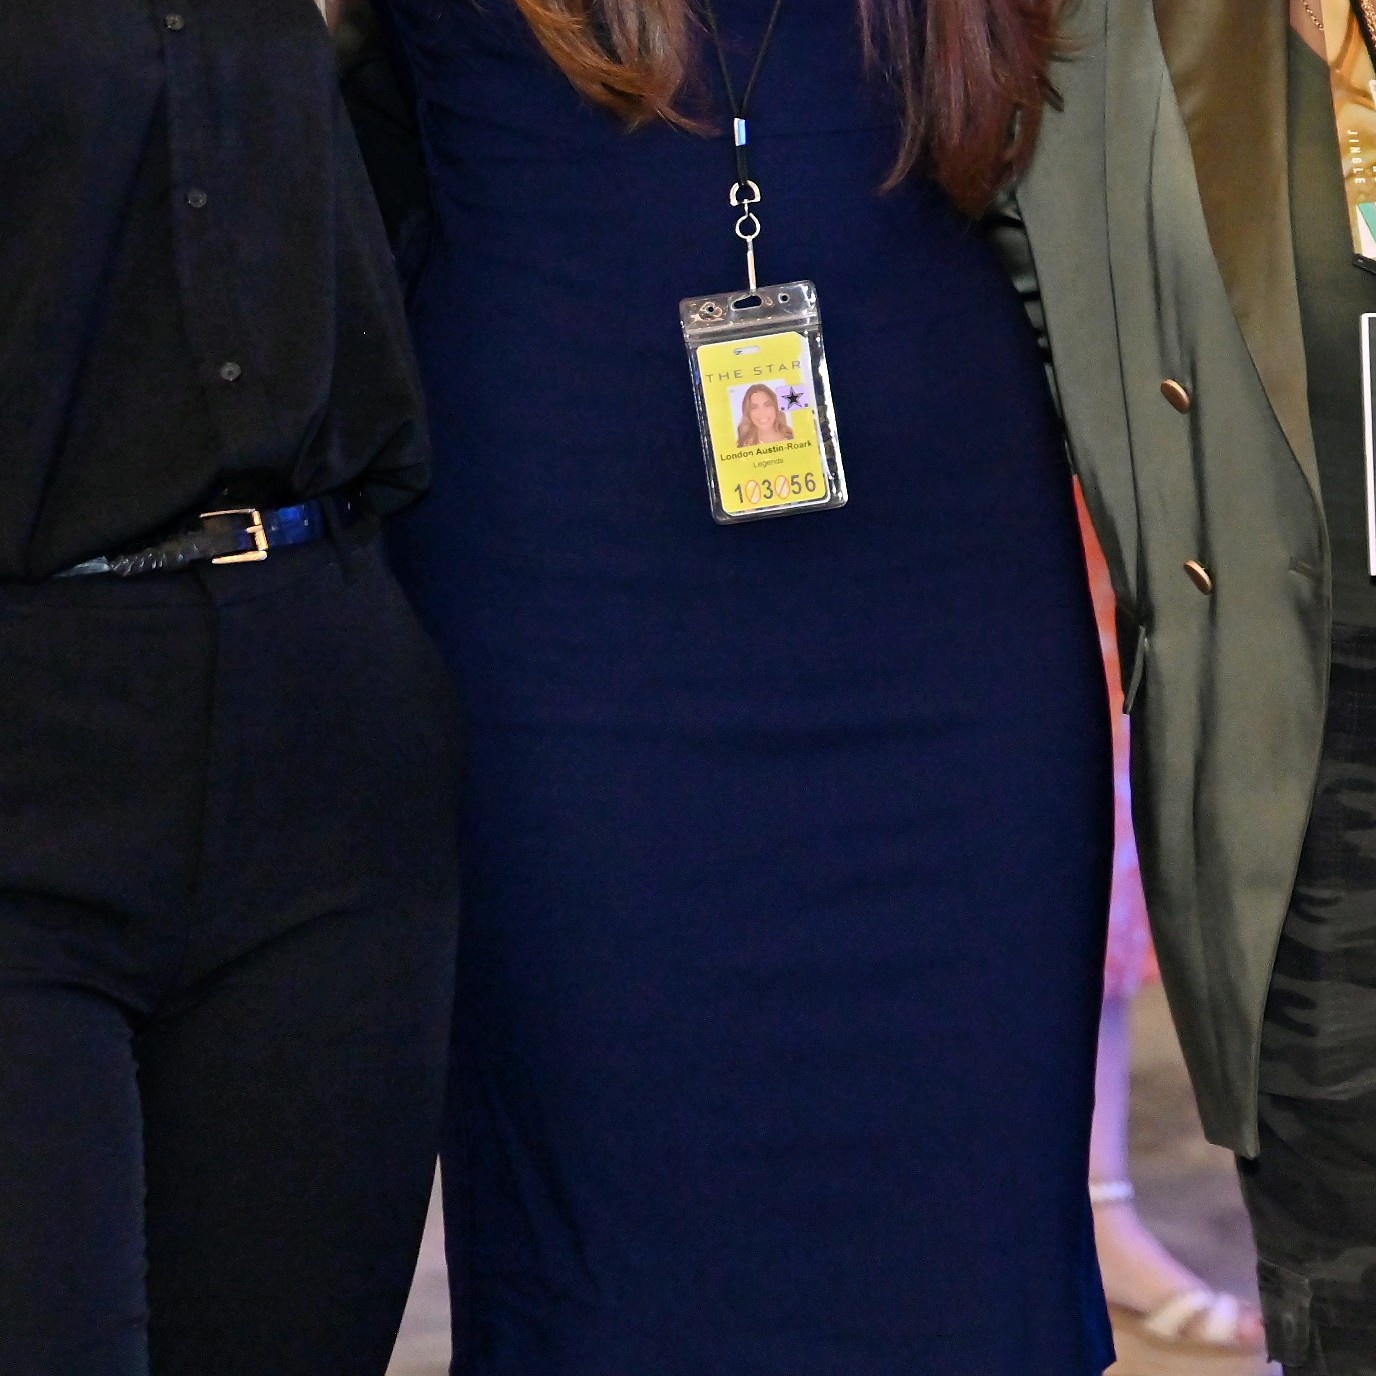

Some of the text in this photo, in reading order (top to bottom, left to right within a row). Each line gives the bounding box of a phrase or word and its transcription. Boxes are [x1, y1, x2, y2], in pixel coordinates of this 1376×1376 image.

[1346, 129, 1366, 185] JINGLE
[705, 360, 801, 383] THE STAR
[720, 439, 813, 461] London Austin-Roark
[753, 457, 784, 469] Legends
